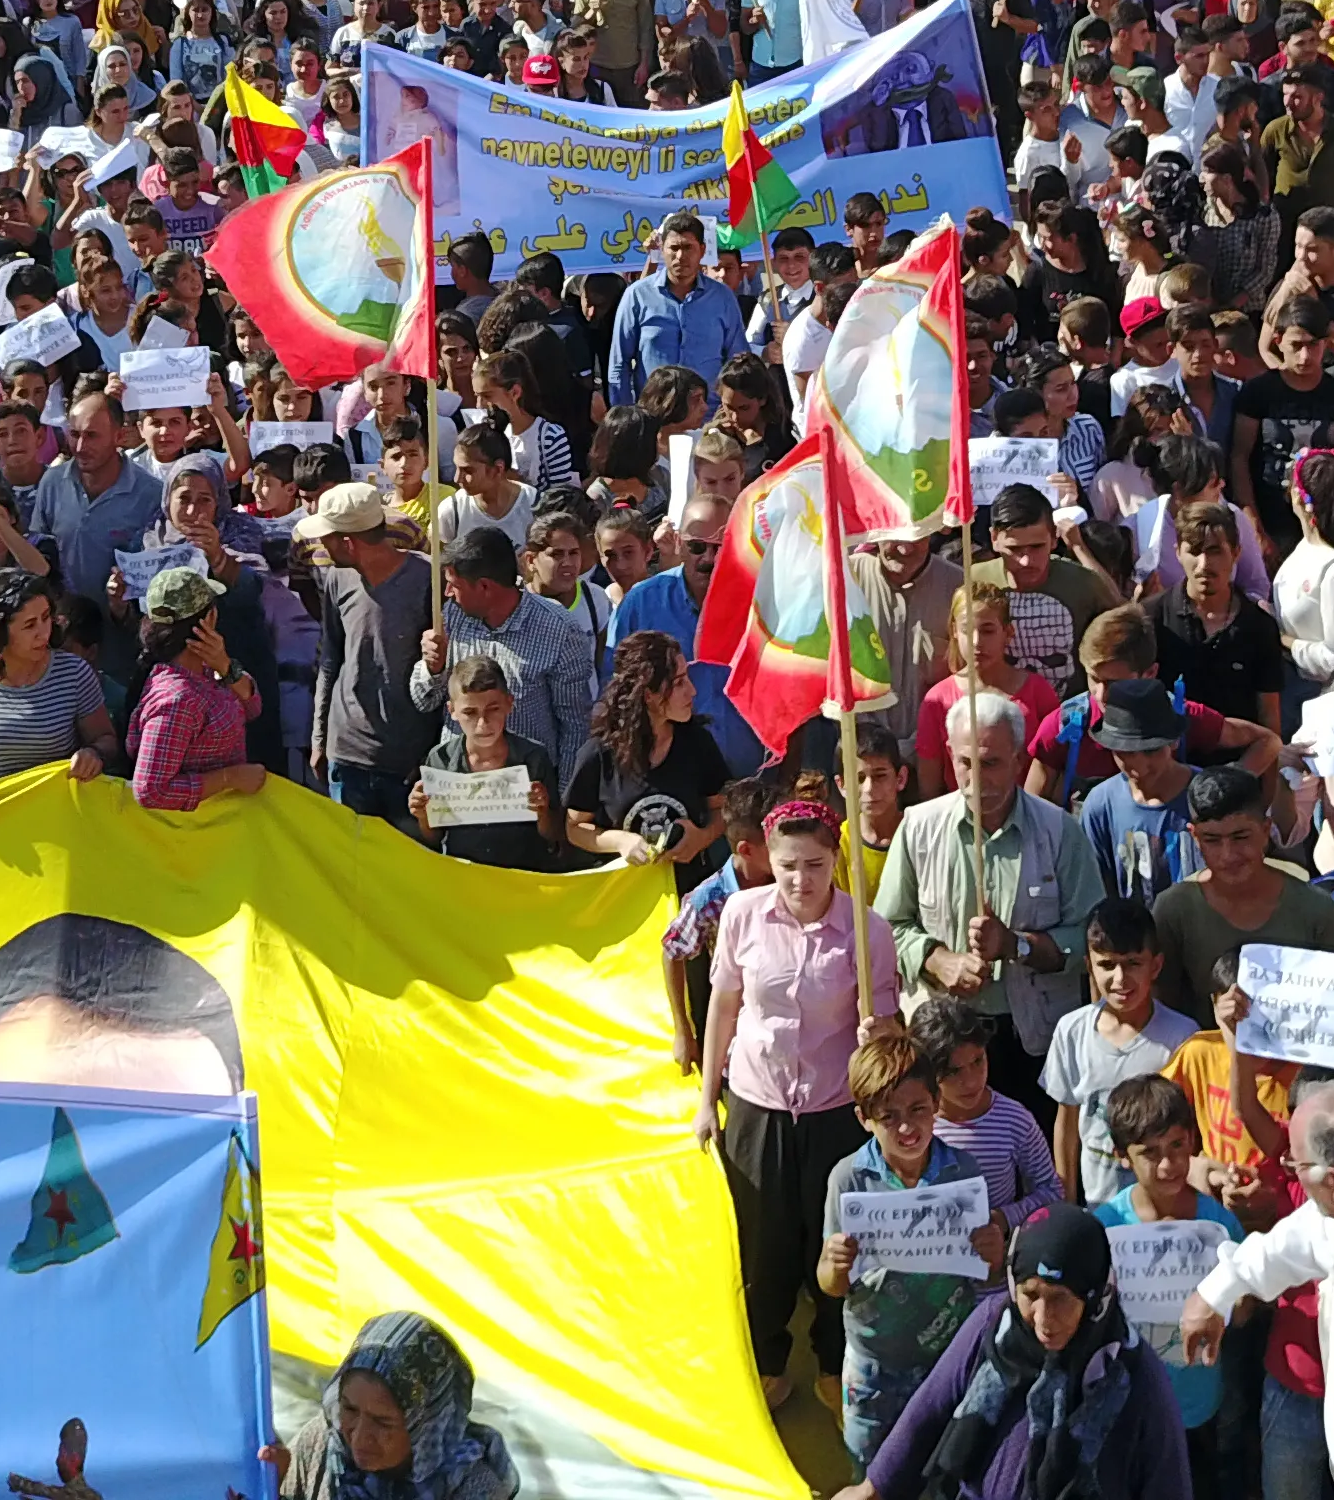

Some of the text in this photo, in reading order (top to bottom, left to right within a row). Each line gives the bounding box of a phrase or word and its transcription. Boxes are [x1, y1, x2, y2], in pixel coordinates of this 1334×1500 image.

[480, 137, 651, 181] navneteweyî
[658, 146, 676, 174] li
[165, 216, 208, 233] SPEED
[899, 1225, 971, 1240] WARGEH
